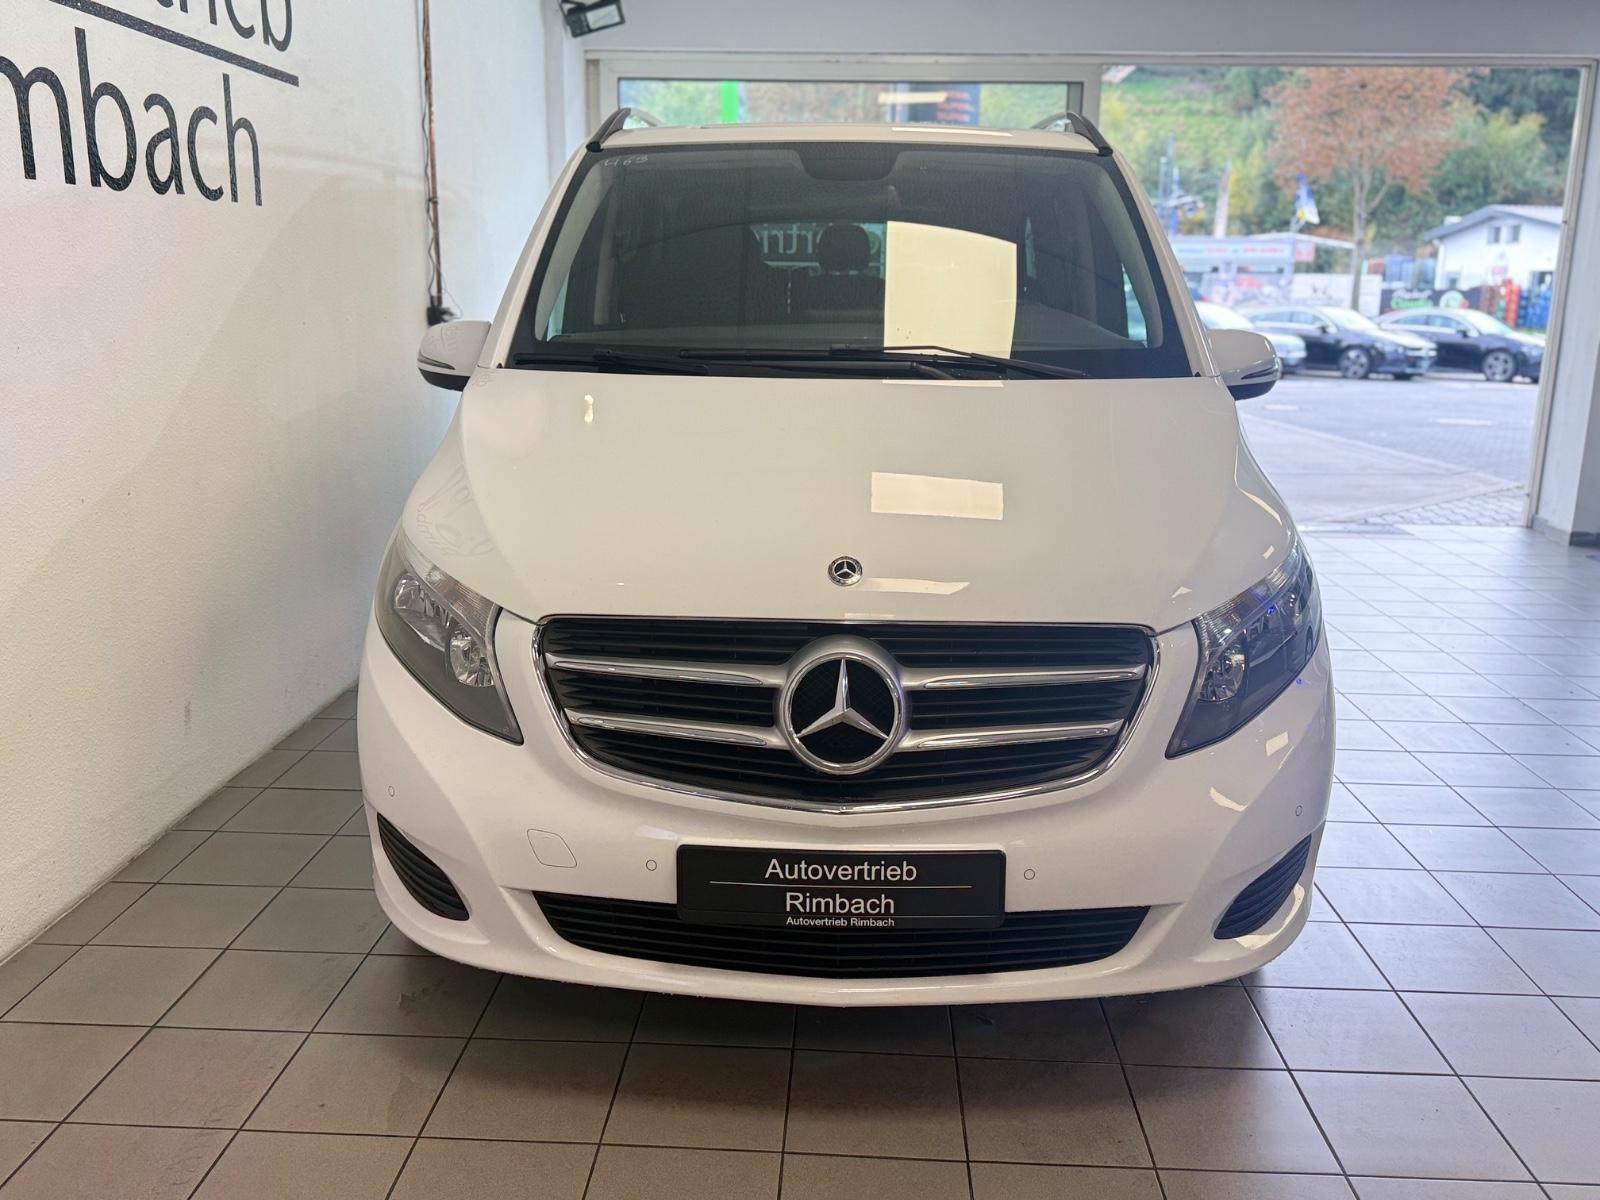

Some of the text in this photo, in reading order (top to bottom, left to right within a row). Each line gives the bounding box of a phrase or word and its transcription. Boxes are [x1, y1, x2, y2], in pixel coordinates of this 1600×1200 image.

[764, 858, 917, 881] Autovertrieb
[785, 892, 895, 914] Rimbach
[785, 916, 895, 927] Autovertrieb Rimbach
